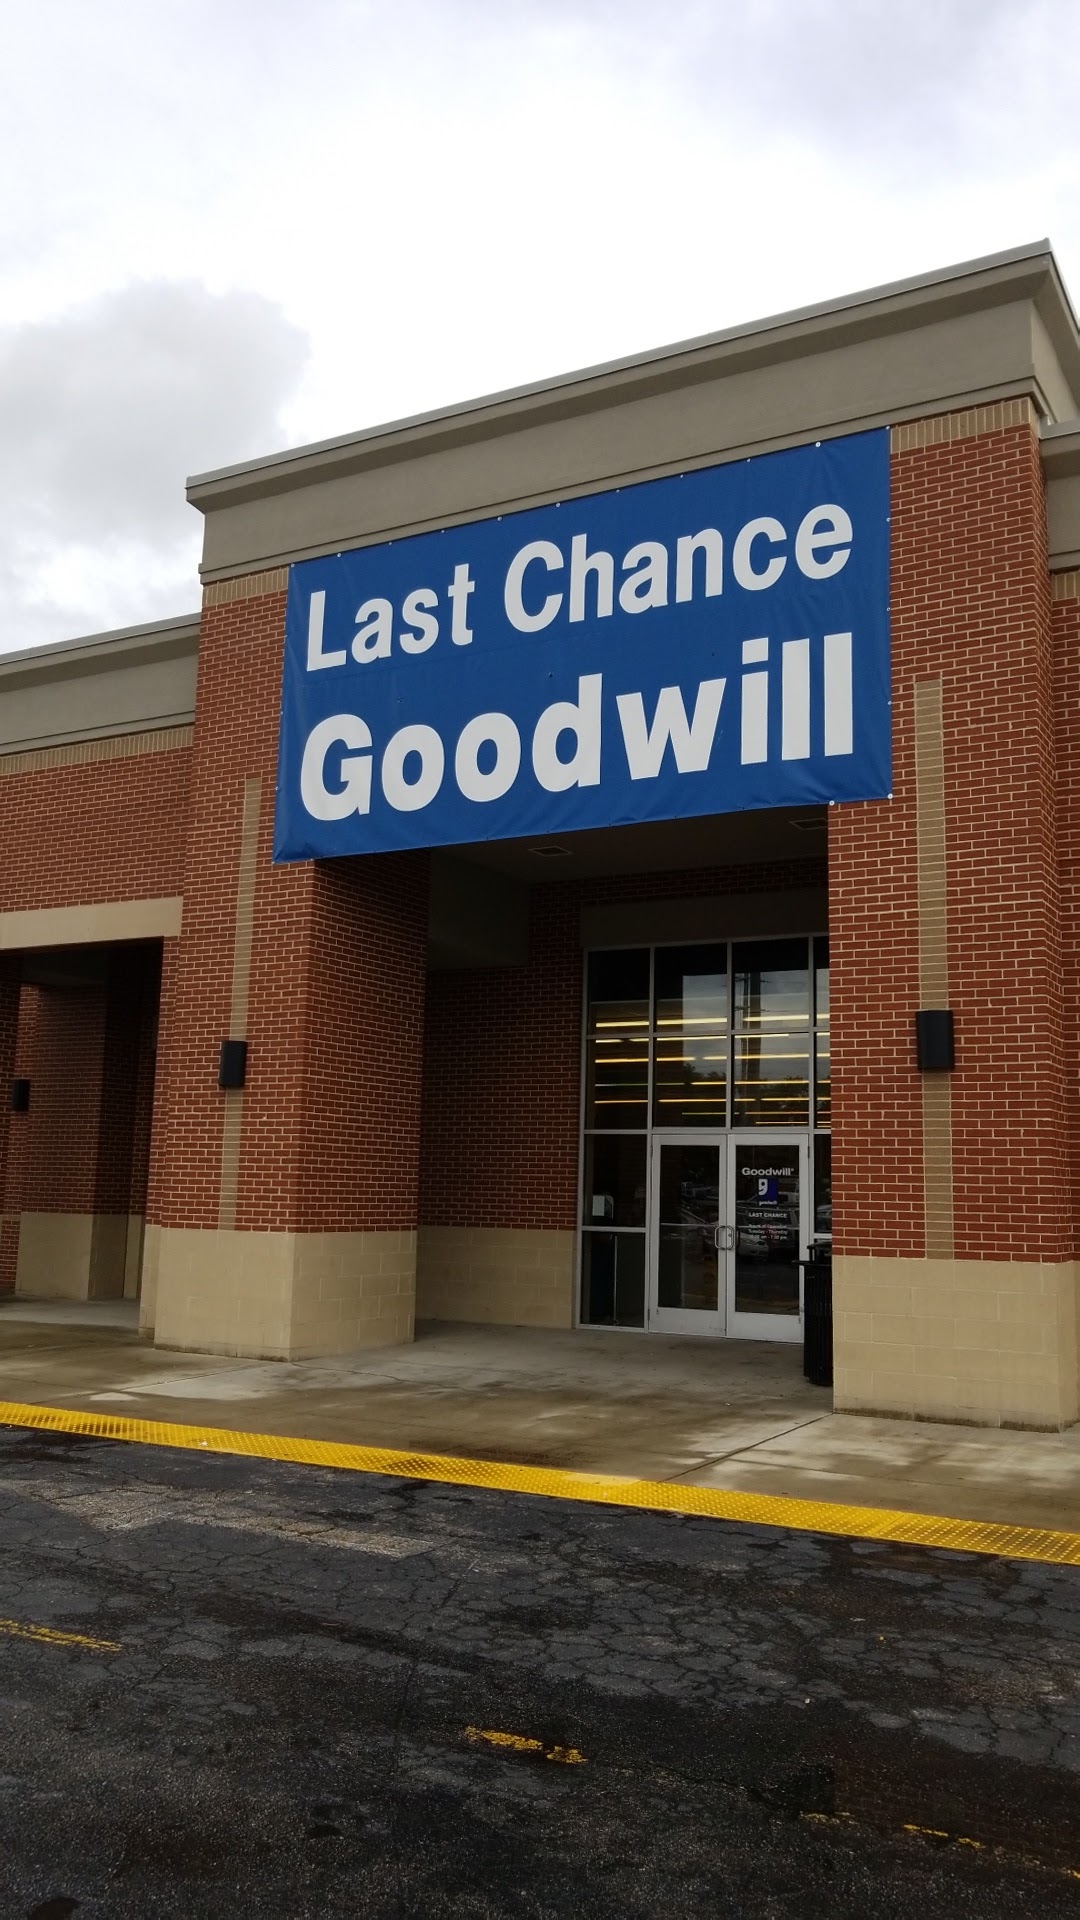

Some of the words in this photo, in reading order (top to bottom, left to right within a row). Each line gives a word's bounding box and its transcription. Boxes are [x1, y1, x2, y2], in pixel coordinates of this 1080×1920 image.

[307, 564, 475, 672] Last
[504, 504, 853, 633] Chance
[301, 632, 853, 821] Goodwill
